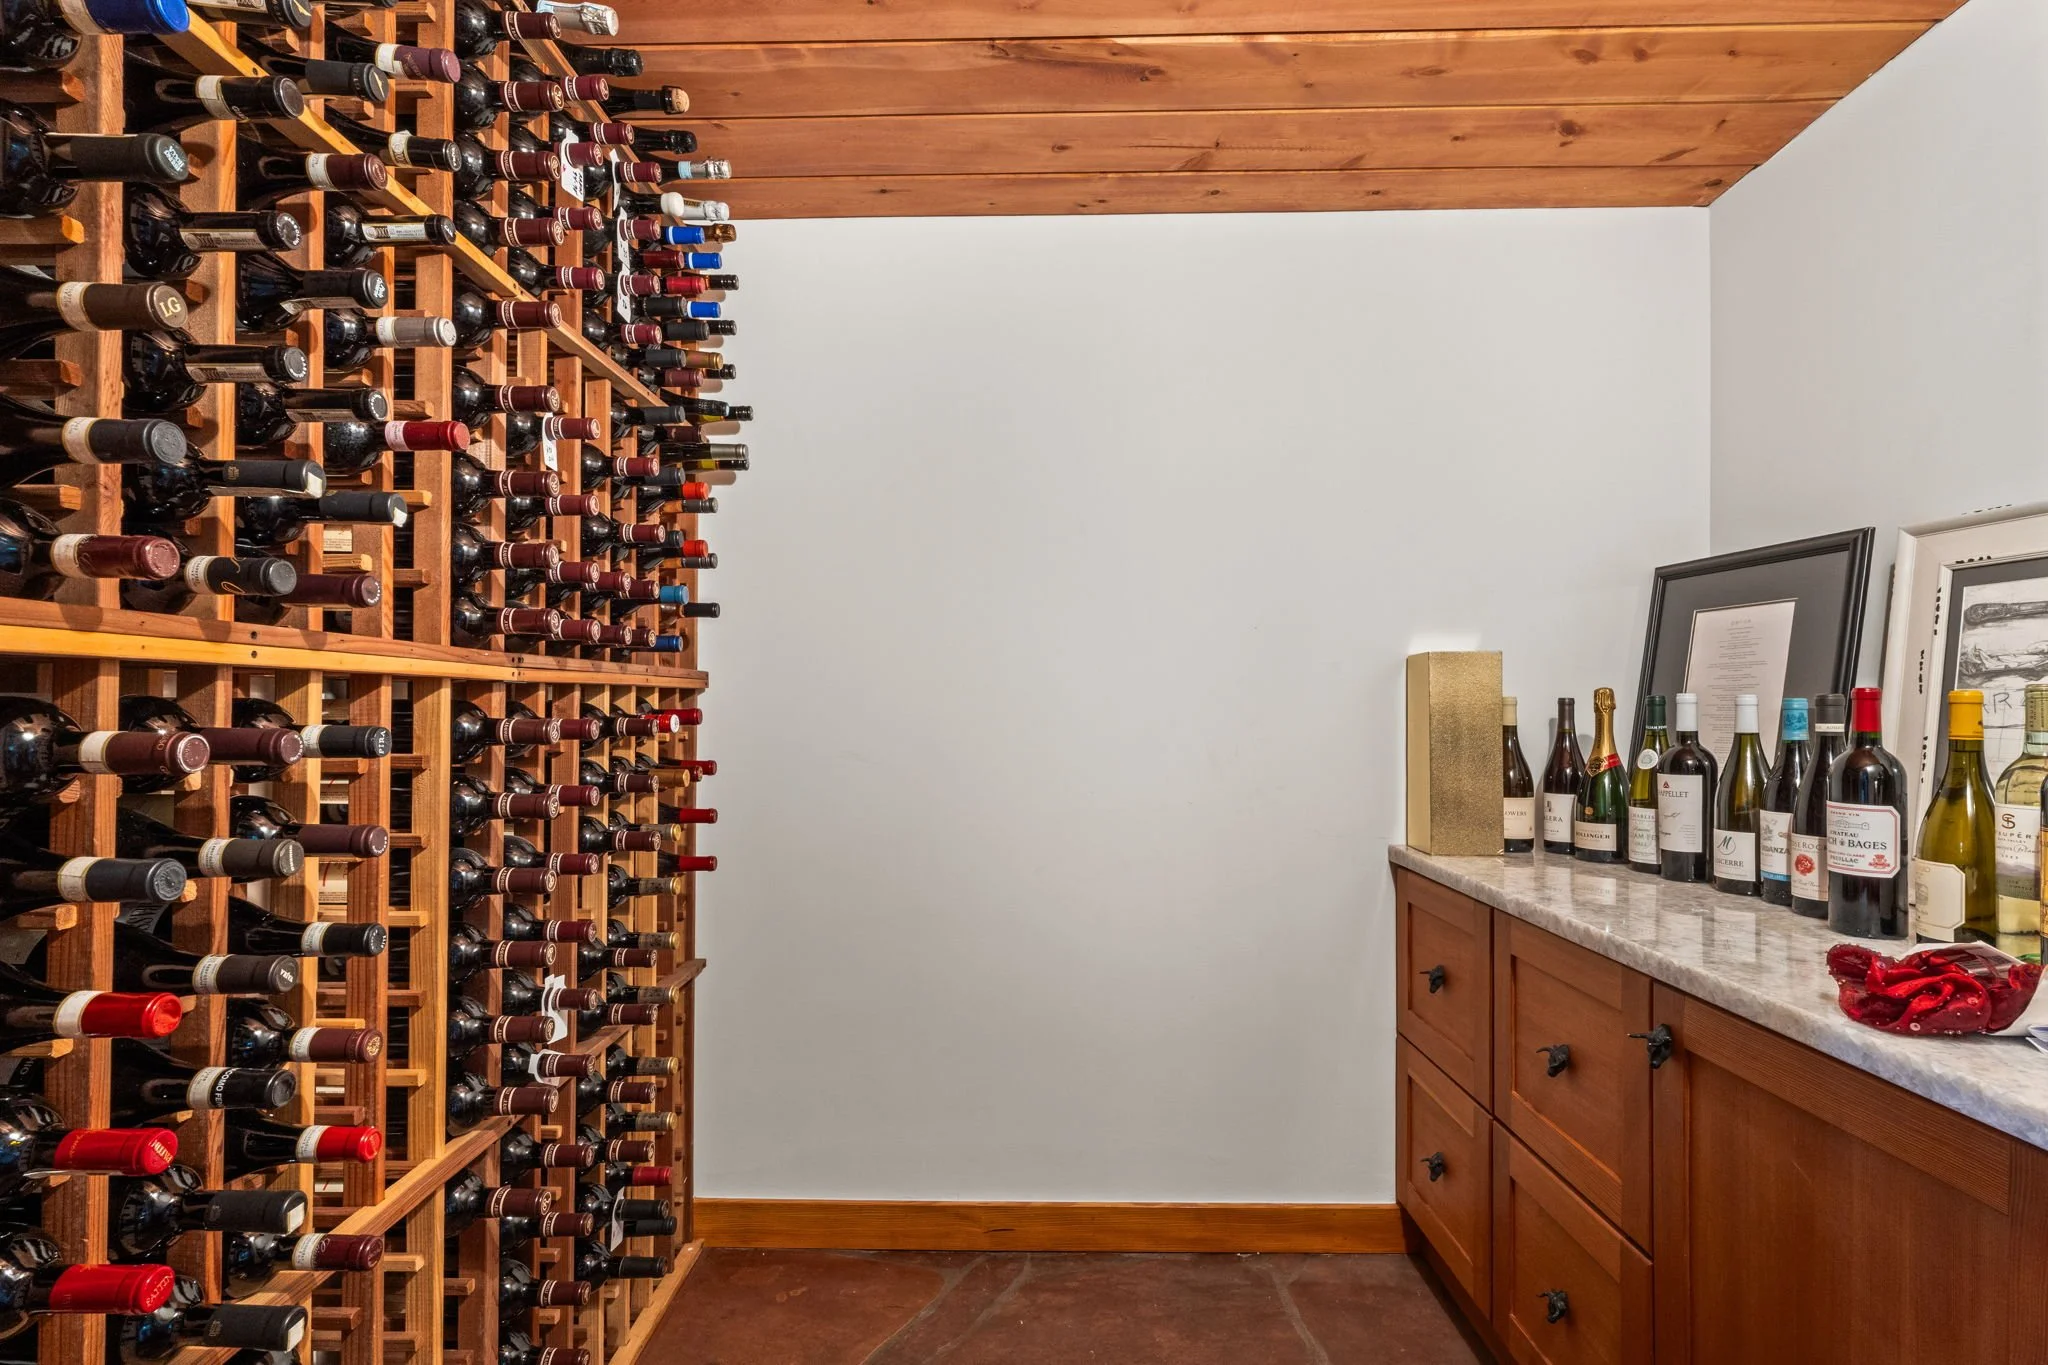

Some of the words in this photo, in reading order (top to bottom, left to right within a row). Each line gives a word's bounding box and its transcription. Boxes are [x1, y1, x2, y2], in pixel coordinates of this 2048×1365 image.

[160, 296, 181, 317] LG
[378, 730, 387, 754] PIRA
[1847, 839, 1888, 850] BAGES
